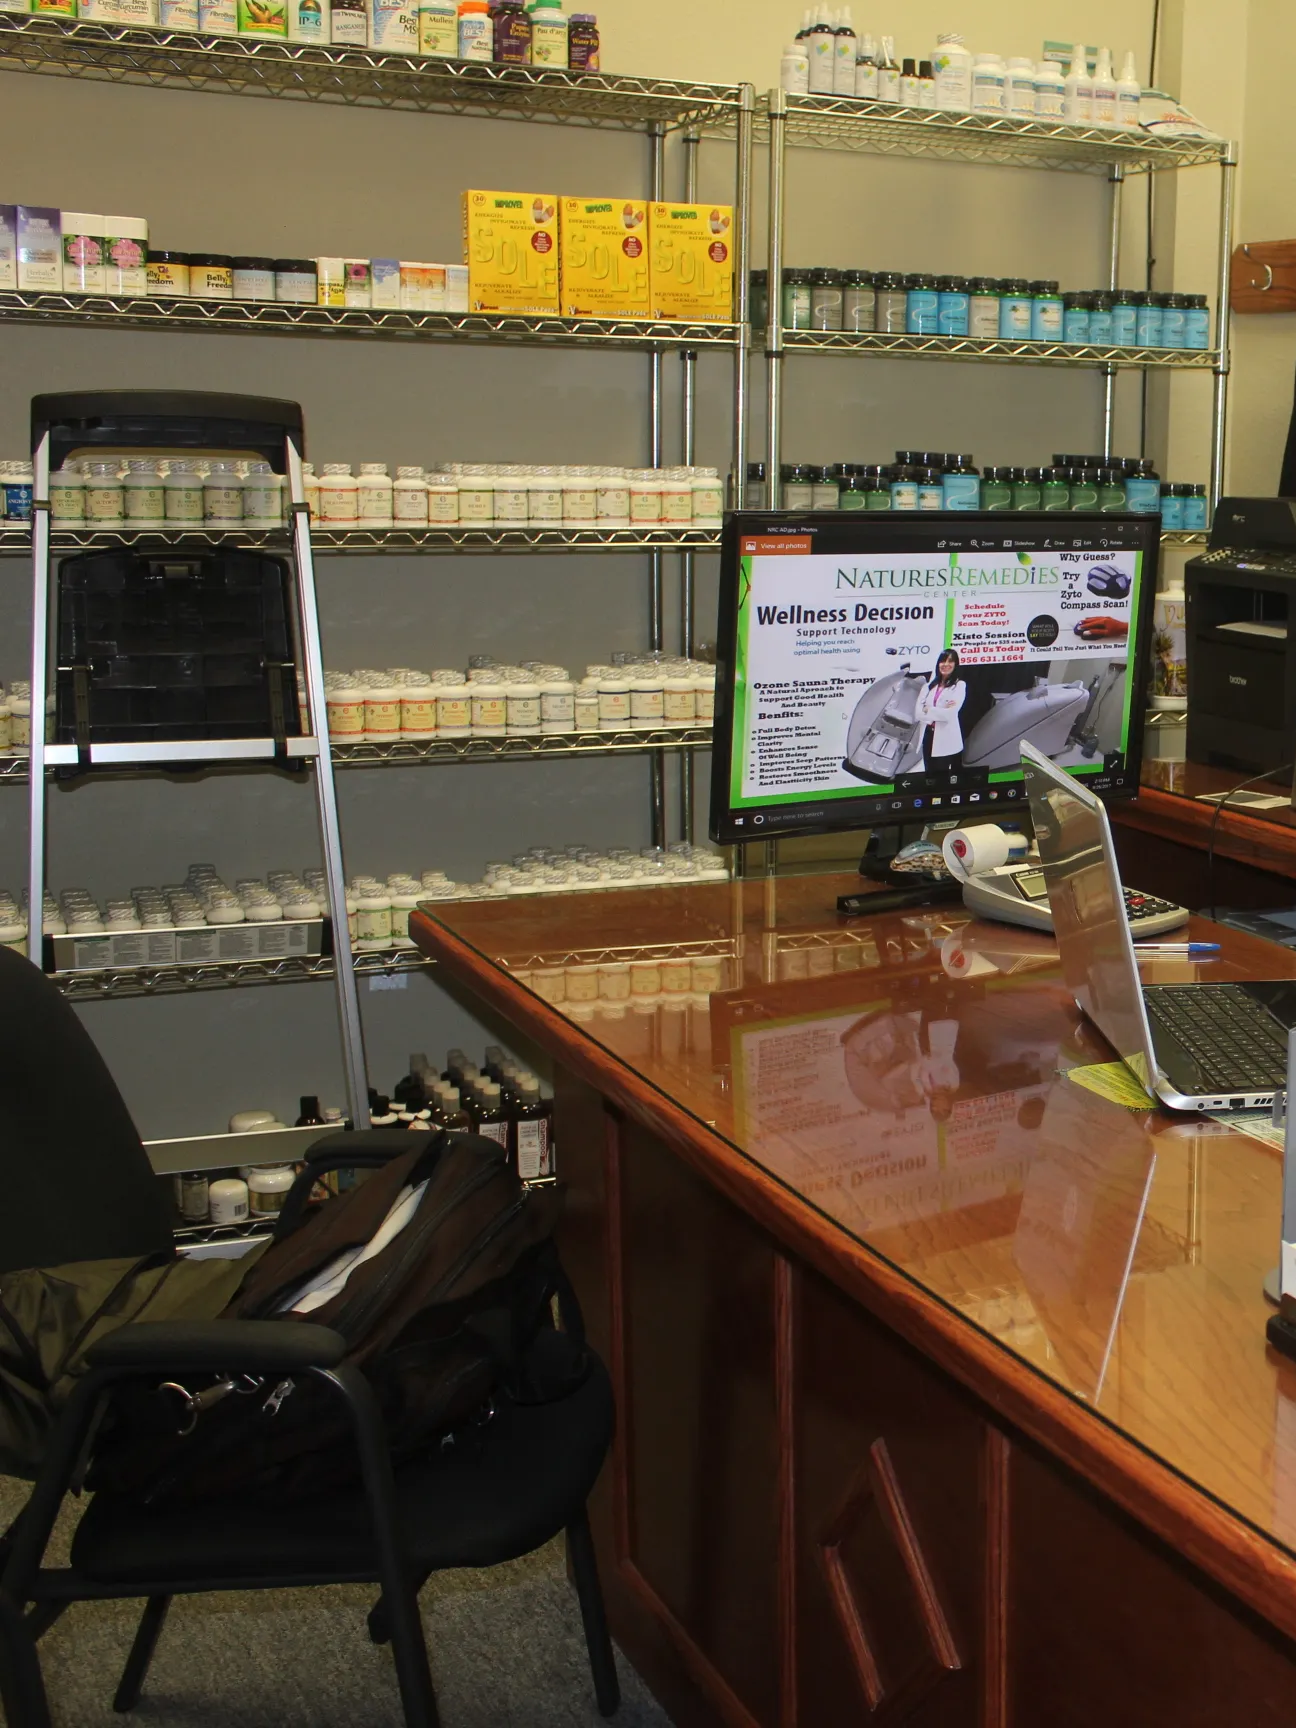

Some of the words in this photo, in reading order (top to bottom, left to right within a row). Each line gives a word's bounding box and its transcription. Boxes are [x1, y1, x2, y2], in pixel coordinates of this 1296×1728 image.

[298, 16, 322, 27] IP-6
[472, 225, 557, 300] SOLE
[567, 230, 647, 303] SOLE
[654, 235, 730, 307] SOLE
[786, 542, 807, 550] photos
[1059, 553, 1082, 562] Why
[1082, 552, 1116, 562] Guess?
[1063, 572, 1081, 582] Try
[1068, 582, 1074, 590] a
[923, 590, 977, 599] CENTER
[1060, 590, 1083, 600] Zyto
[964, 603, 1005, 611] Schedule
[1060, 601, 1101, 611] Compass
[1102, 600, 1129, 609] Scan!
[757, 604, 847, 626] Wellness
[854, 602, 934, 622] Decision
[962, 612, 983, 620] your
[980, 619, 1010, 627] Today!
[796, 628, 838, 638] Support
[841, 625, 897, 636] Technology
[952, 632, 983, 641] Xisto
[985, 631, 1026, 639] Session
[793, 649, 820, 657] optimal
[843, 647, 861, 655] using
[898, 645, 931, 656] ZYTO
[960, 646, 981, 654] Call
[995, 645, 1026, 654] Today
[960, 655, 978, 664] 956
[980, 654, 1024, 663] 631.1664
[753, 681, 790, 690] Ozone
[792, 679, 828, 688] Sauna
[830, 676, 876, 685] Therapy
[1229, 675, 1247, 686] brother
[766, 687, 799, 695] Natural
[800, 685, 835, 693] Aproach
[758, 695, 793, 703] Support
[758, 711, 804, 720] Benfits:
[814, 754, 846, 762] Patterns
[786, 764, 812, 772] Energy
[793, 768, 838, 776] Smoothness
[539, 1118, 548, 1157] shampoo
